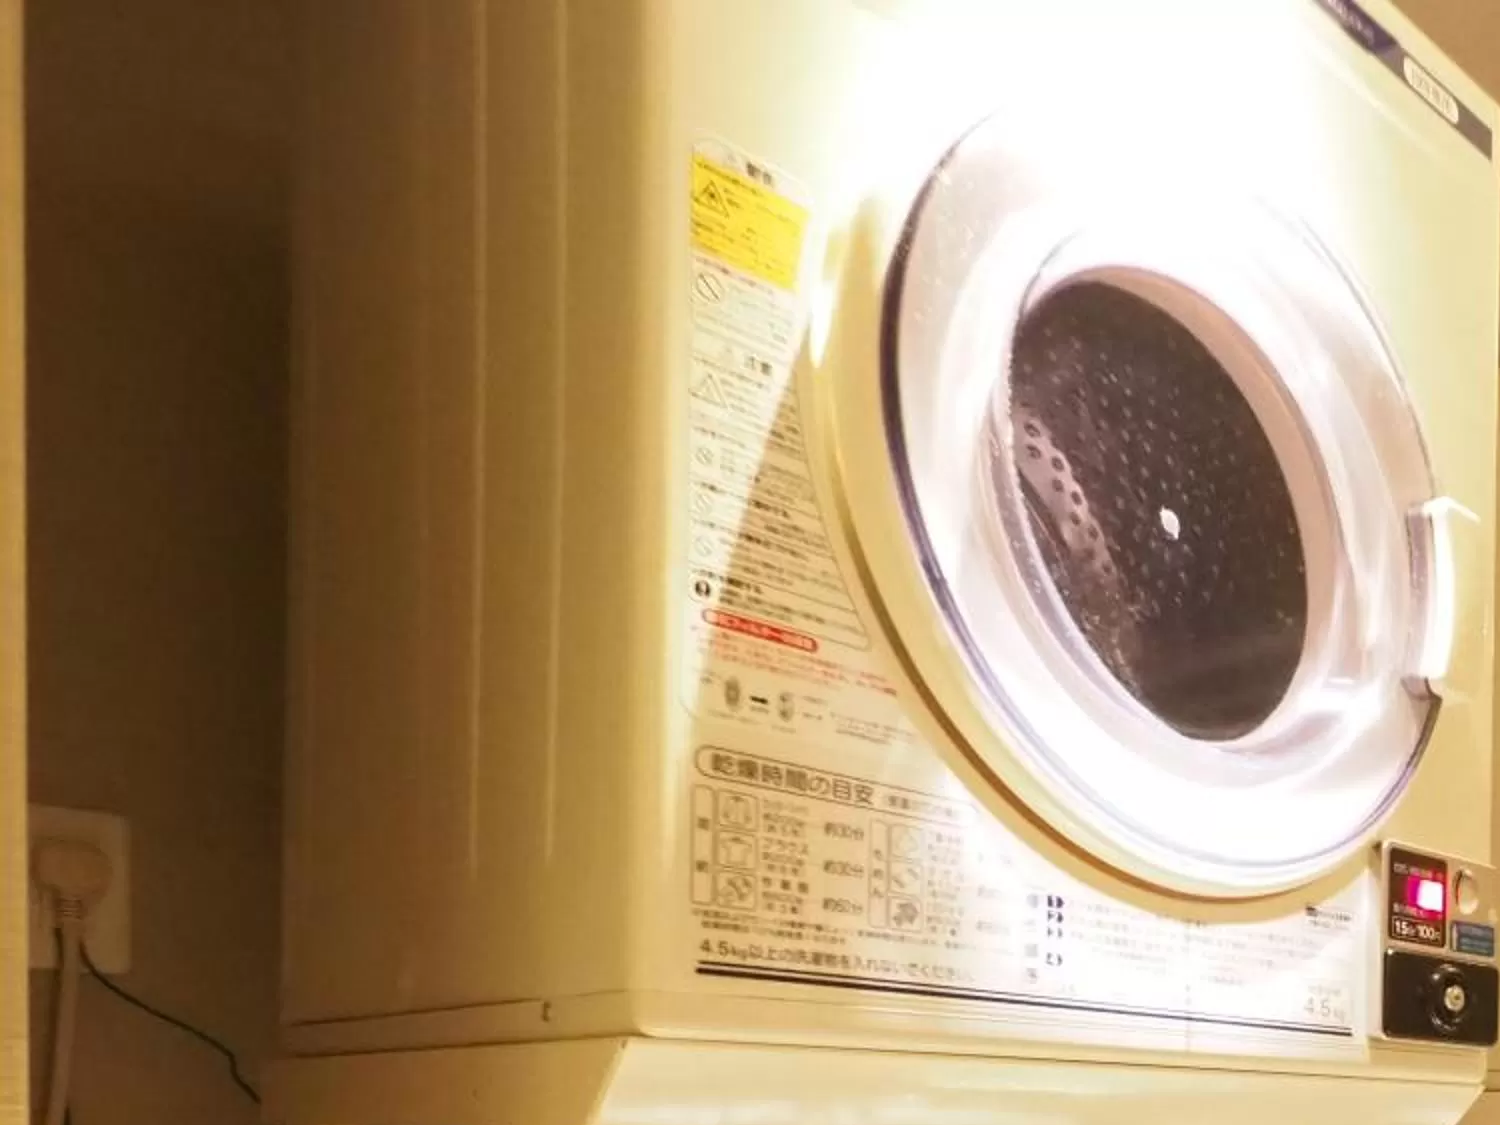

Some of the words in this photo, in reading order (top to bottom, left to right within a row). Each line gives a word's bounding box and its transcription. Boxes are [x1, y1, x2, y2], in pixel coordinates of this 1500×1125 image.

[711, 752, 875, 805] 乾燥時間の目安
